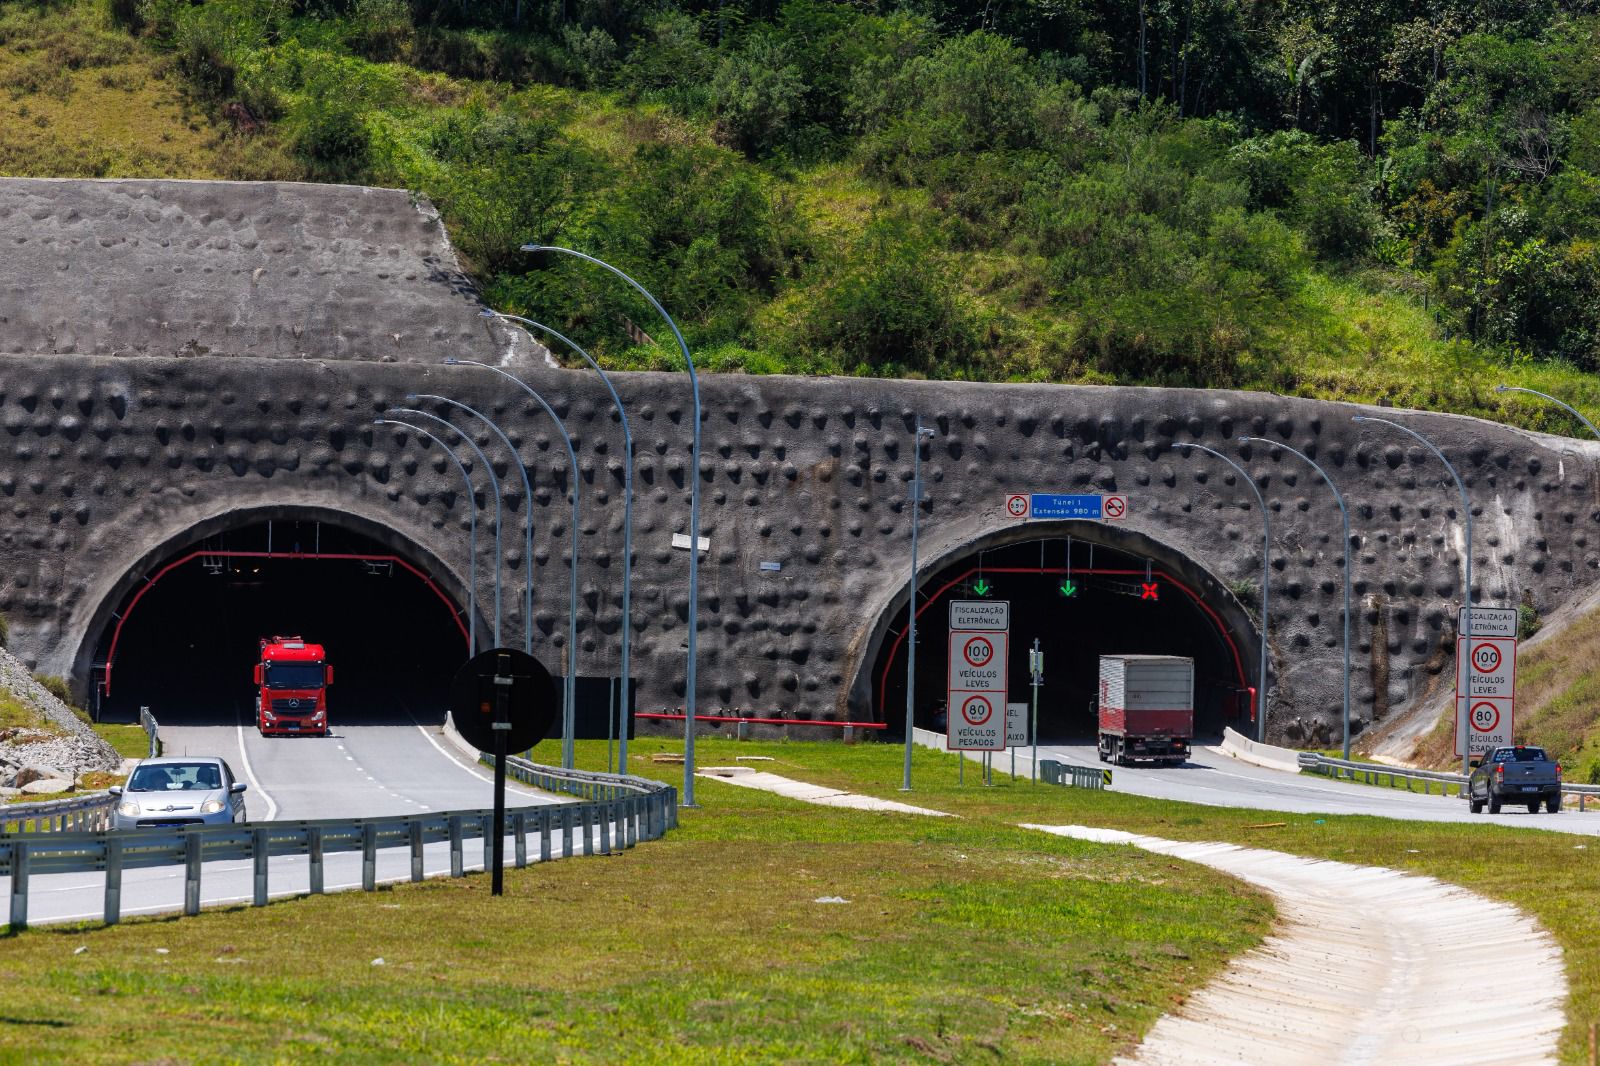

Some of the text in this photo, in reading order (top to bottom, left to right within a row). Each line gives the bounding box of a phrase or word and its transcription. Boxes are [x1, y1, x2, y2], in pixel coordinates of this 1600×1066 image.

[1033, 507, 1070, 515] Extensão
[955, 606, 1004, 616] FISCALIZAÇÃO
[958, 616, 1000, 625] ELETRÔNICA
[1471, 623, 1509, 632] LETRÔNICA
[968, 646, 990, 657] 100
[1477, 651, 1498, 663] 100
[959, 667, 997, 678] VEÍCULOS
[965, 680, 990, 688] LEVES
[1473, 686, 1497, 694] LEVES
[969, 705, 985, 715] 80
[1476, 711, 1492, 721] 80
[957, 727, 996, 737] VEÍCULOS
[958, 738, 995, 746] PESADOS
[1471, 733, 1503, 743] EÍCULOS
